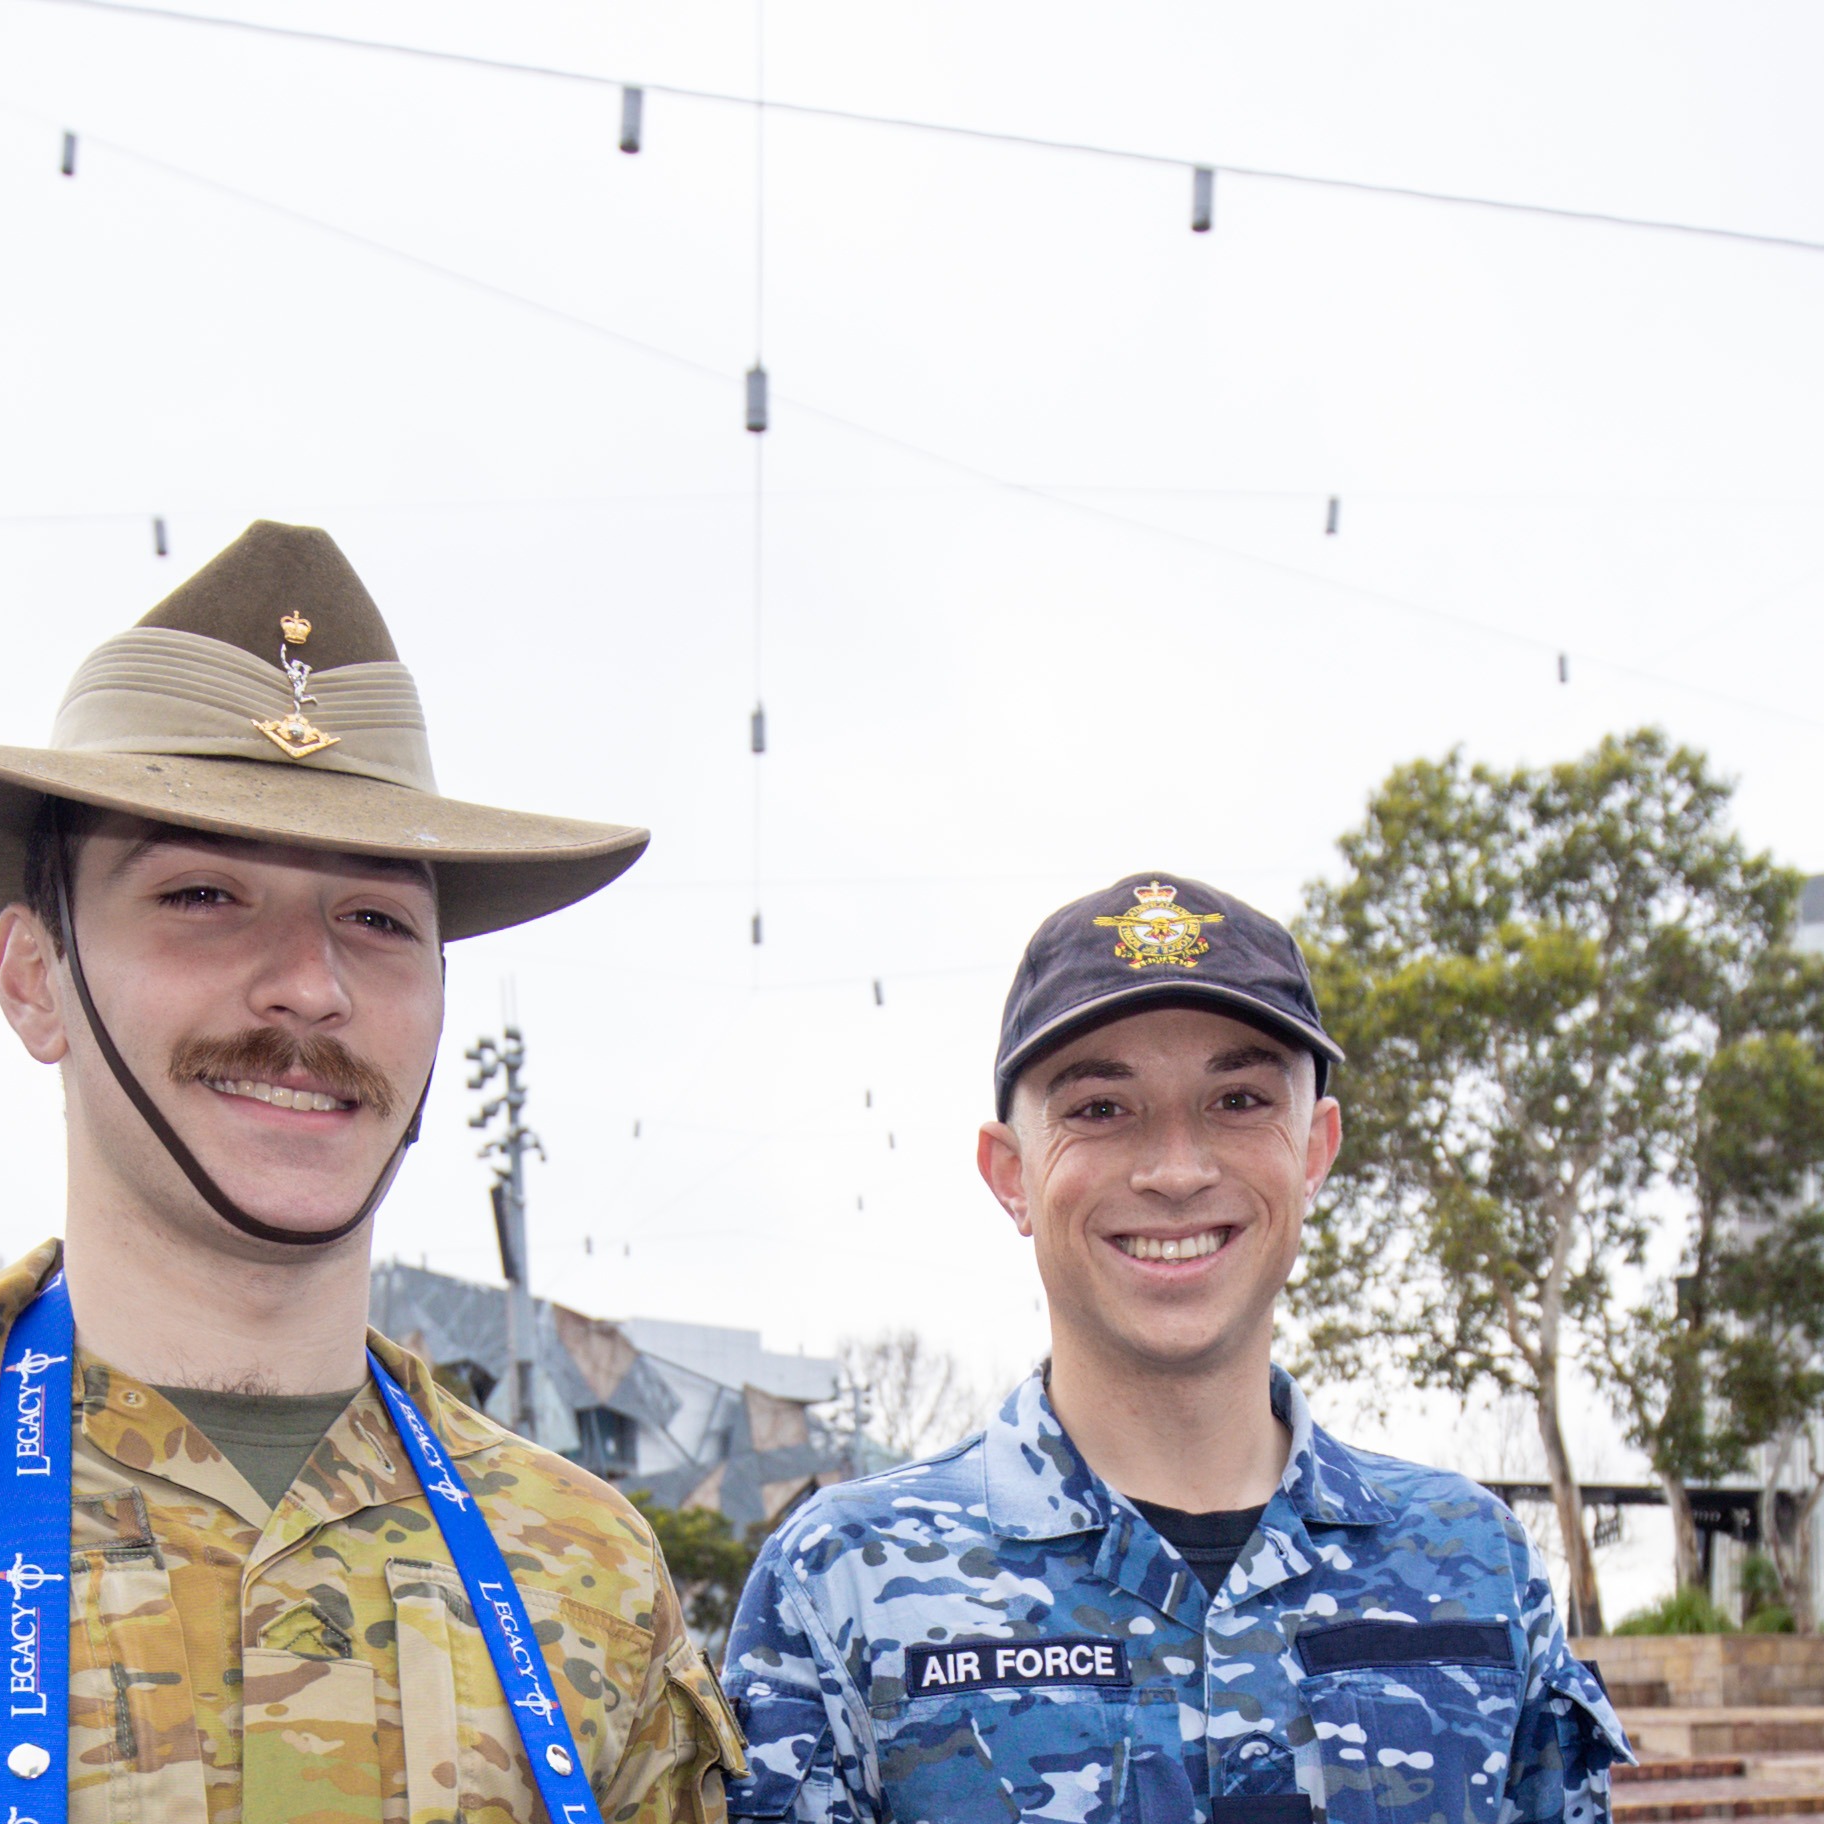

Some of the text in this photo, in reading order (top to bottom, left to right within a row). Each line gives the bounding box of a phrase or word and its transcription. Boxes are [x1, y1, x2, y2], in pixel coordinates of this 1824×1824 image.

[16, 1384, 50, 1477] LEGACY
[385, 1382, 448, 1481] LEGACY
[10, 1602, 47, 1718] LEGACY
[477, 1580, 538, 1685] LEGACY
[921, 1644, 1116, 1688] AIR FORCE
